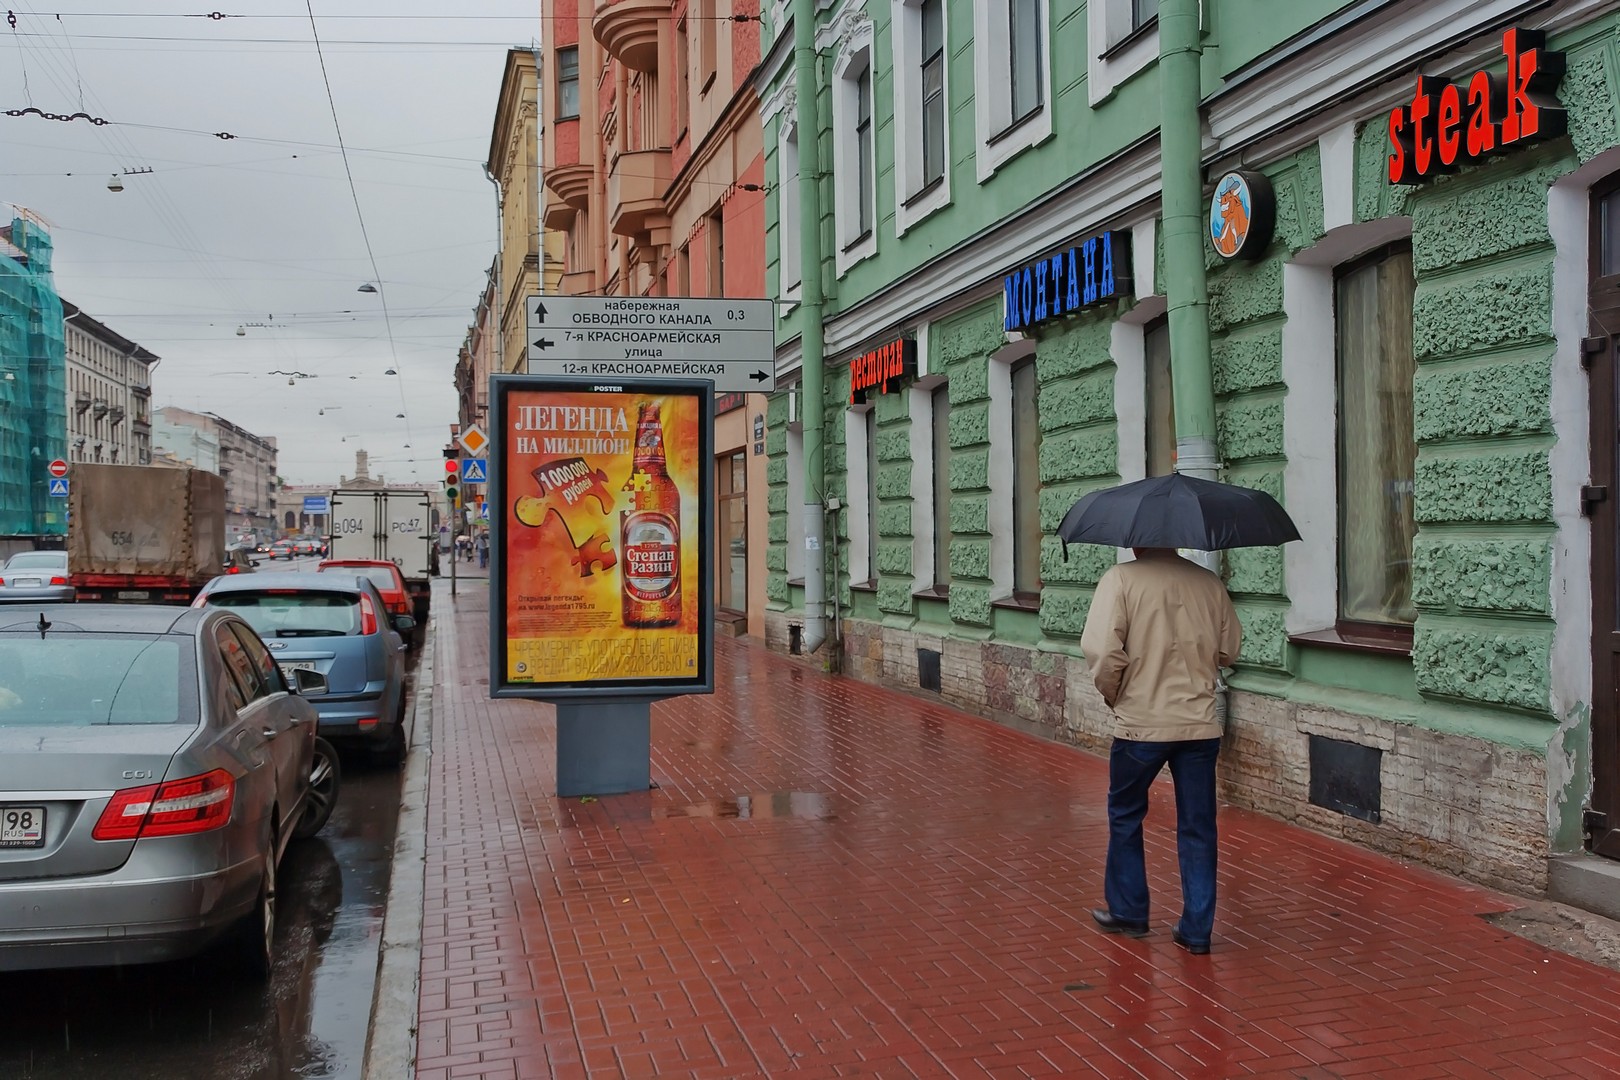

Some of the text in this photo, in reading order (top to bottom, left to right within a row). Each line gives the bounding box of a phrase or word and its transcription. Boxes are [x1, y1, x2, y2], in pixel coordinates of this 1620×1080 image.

[1389, 27, 1539, 183] steak
[1004, 231, 1114, 331] МОНТАНА
[604, 300, 680, 312] набережная
[572, 313, 712, 326] ОБВОДНОГО КАНАЛА
[727, 310, 745, 321] 0,3
[565, 330, 720, 343] 7-я КРАСНОАРМЕЙСКАЯ
[625, 348, 663, 358] улица
[562, 362, 725, 374] 12-я КРАСНОАРМЕЙСКАЯ
[850, 337, 903, 405] ресторан
[515, 406, 629, 437] ЛЕГЕНДА
[516, 437, 539, 454] НА
[544, 437, 630, 455] МИЛЛИОН!
[562, 475, 594, 506] рублей
[112, 531, 133, 546] 654
[626, 548, 675, 562] Степан
[630, 561, 673, 574] Разин
[514, 637, 696, 658] ЧРЕЗМЕРНОЕ УПОТРЕБЛЕНИЕ ПИВА
[530, 658, 570, 676] ВРЕДИТ
[624, 655, 682, 675] ЗДОРОВЬЮ
[122, 769, 153, 780] CGI
[6, 811, 33, 830] 98
[4, 830, 24, 838] RUS
